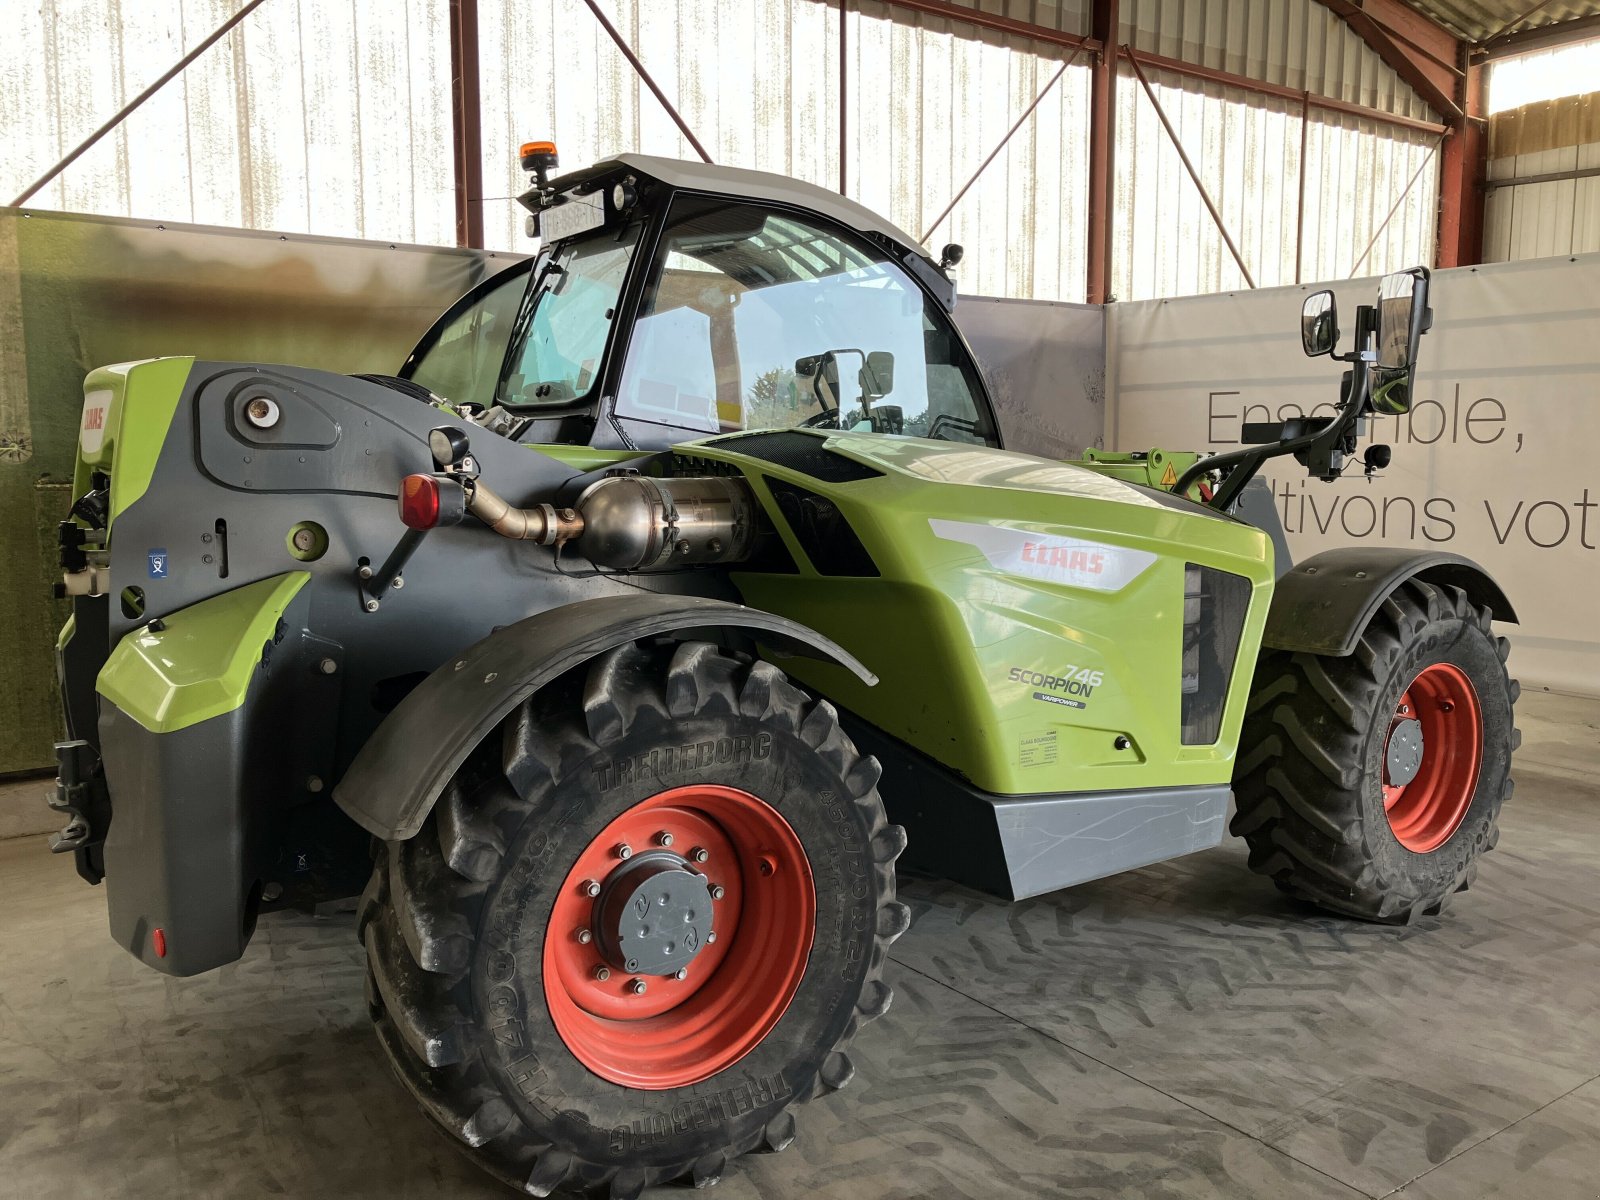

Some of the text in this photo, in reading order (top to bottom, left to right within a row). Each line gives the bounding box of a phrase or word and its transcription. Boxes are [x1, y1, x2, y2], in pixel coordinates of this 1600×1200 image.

[1484, 488, 1598, 550] vot
[1020, 541, 1104, 574] CLAAS
[1008, 667, 1094, 698] SCORPION
[1063, 664, 1104, 687] 746
[1041, 694, 1079, 708] VARIPOWER
[592, 732, 772, 794] TRELLEBORG
[610, 1071, 793, 1157] TRELLEBORG
